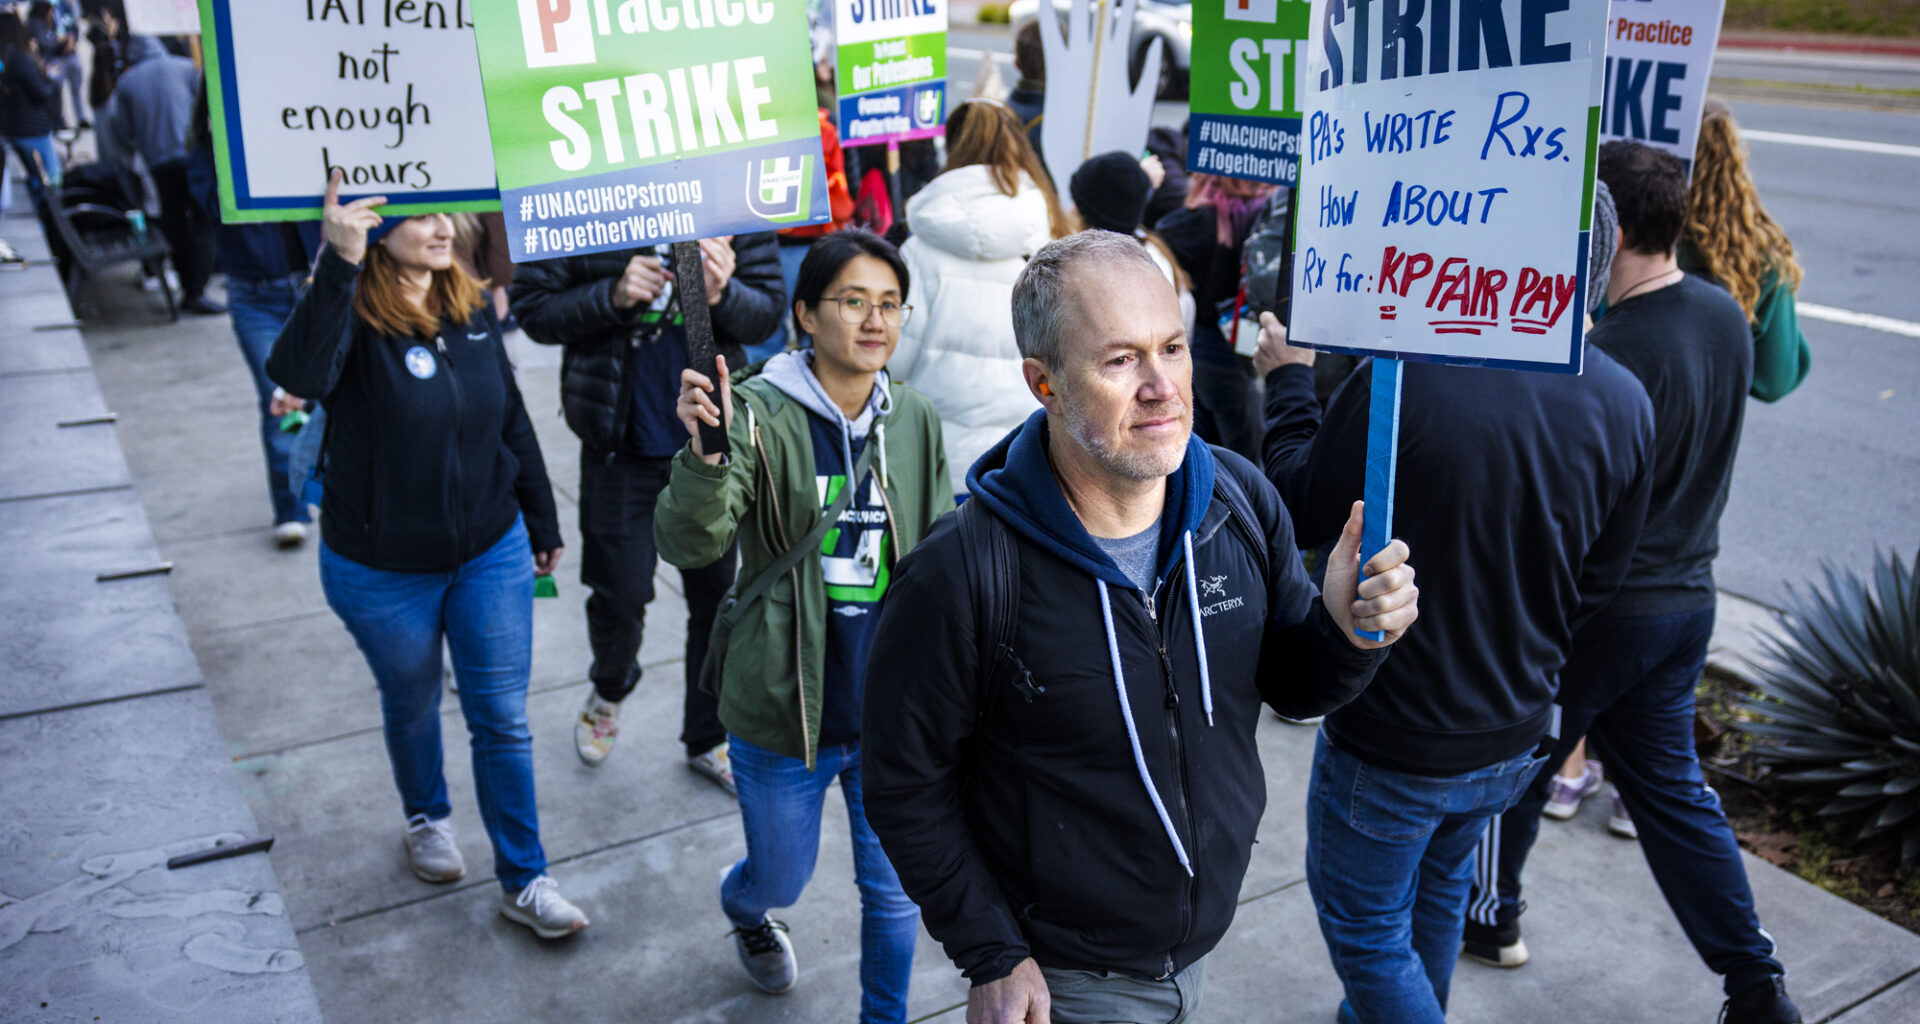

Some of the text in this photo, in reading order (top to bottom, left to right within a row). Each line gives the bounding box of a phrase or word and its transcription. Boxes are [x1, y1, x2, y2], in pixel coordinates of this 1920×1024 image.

[1320, 0, 1571, 92] STRIKE
[1616, 17, 1693, 46] Practice
[338, 43, 399, 83] not
[282, 83, 430, 149] enough
[542, 56, 778, 171] STRIKE
[1310, 91, 1570, 165] PA's WRITE Rxs.
[322, 147, 431, 189] hours
[1197, 147, 1300, 182] #TogetherWe
[520, 179, 703, 222] #UNACUHCPstrong
[1382, 180, 1508, 227] ABOUT
[524, 209, 695, 254] #TogetherWeWin
[1378, 246, 1434, 297] KP
[1426, 257, 1508, 320] FAIR
[1509, 267, 1577, 327] PAY
